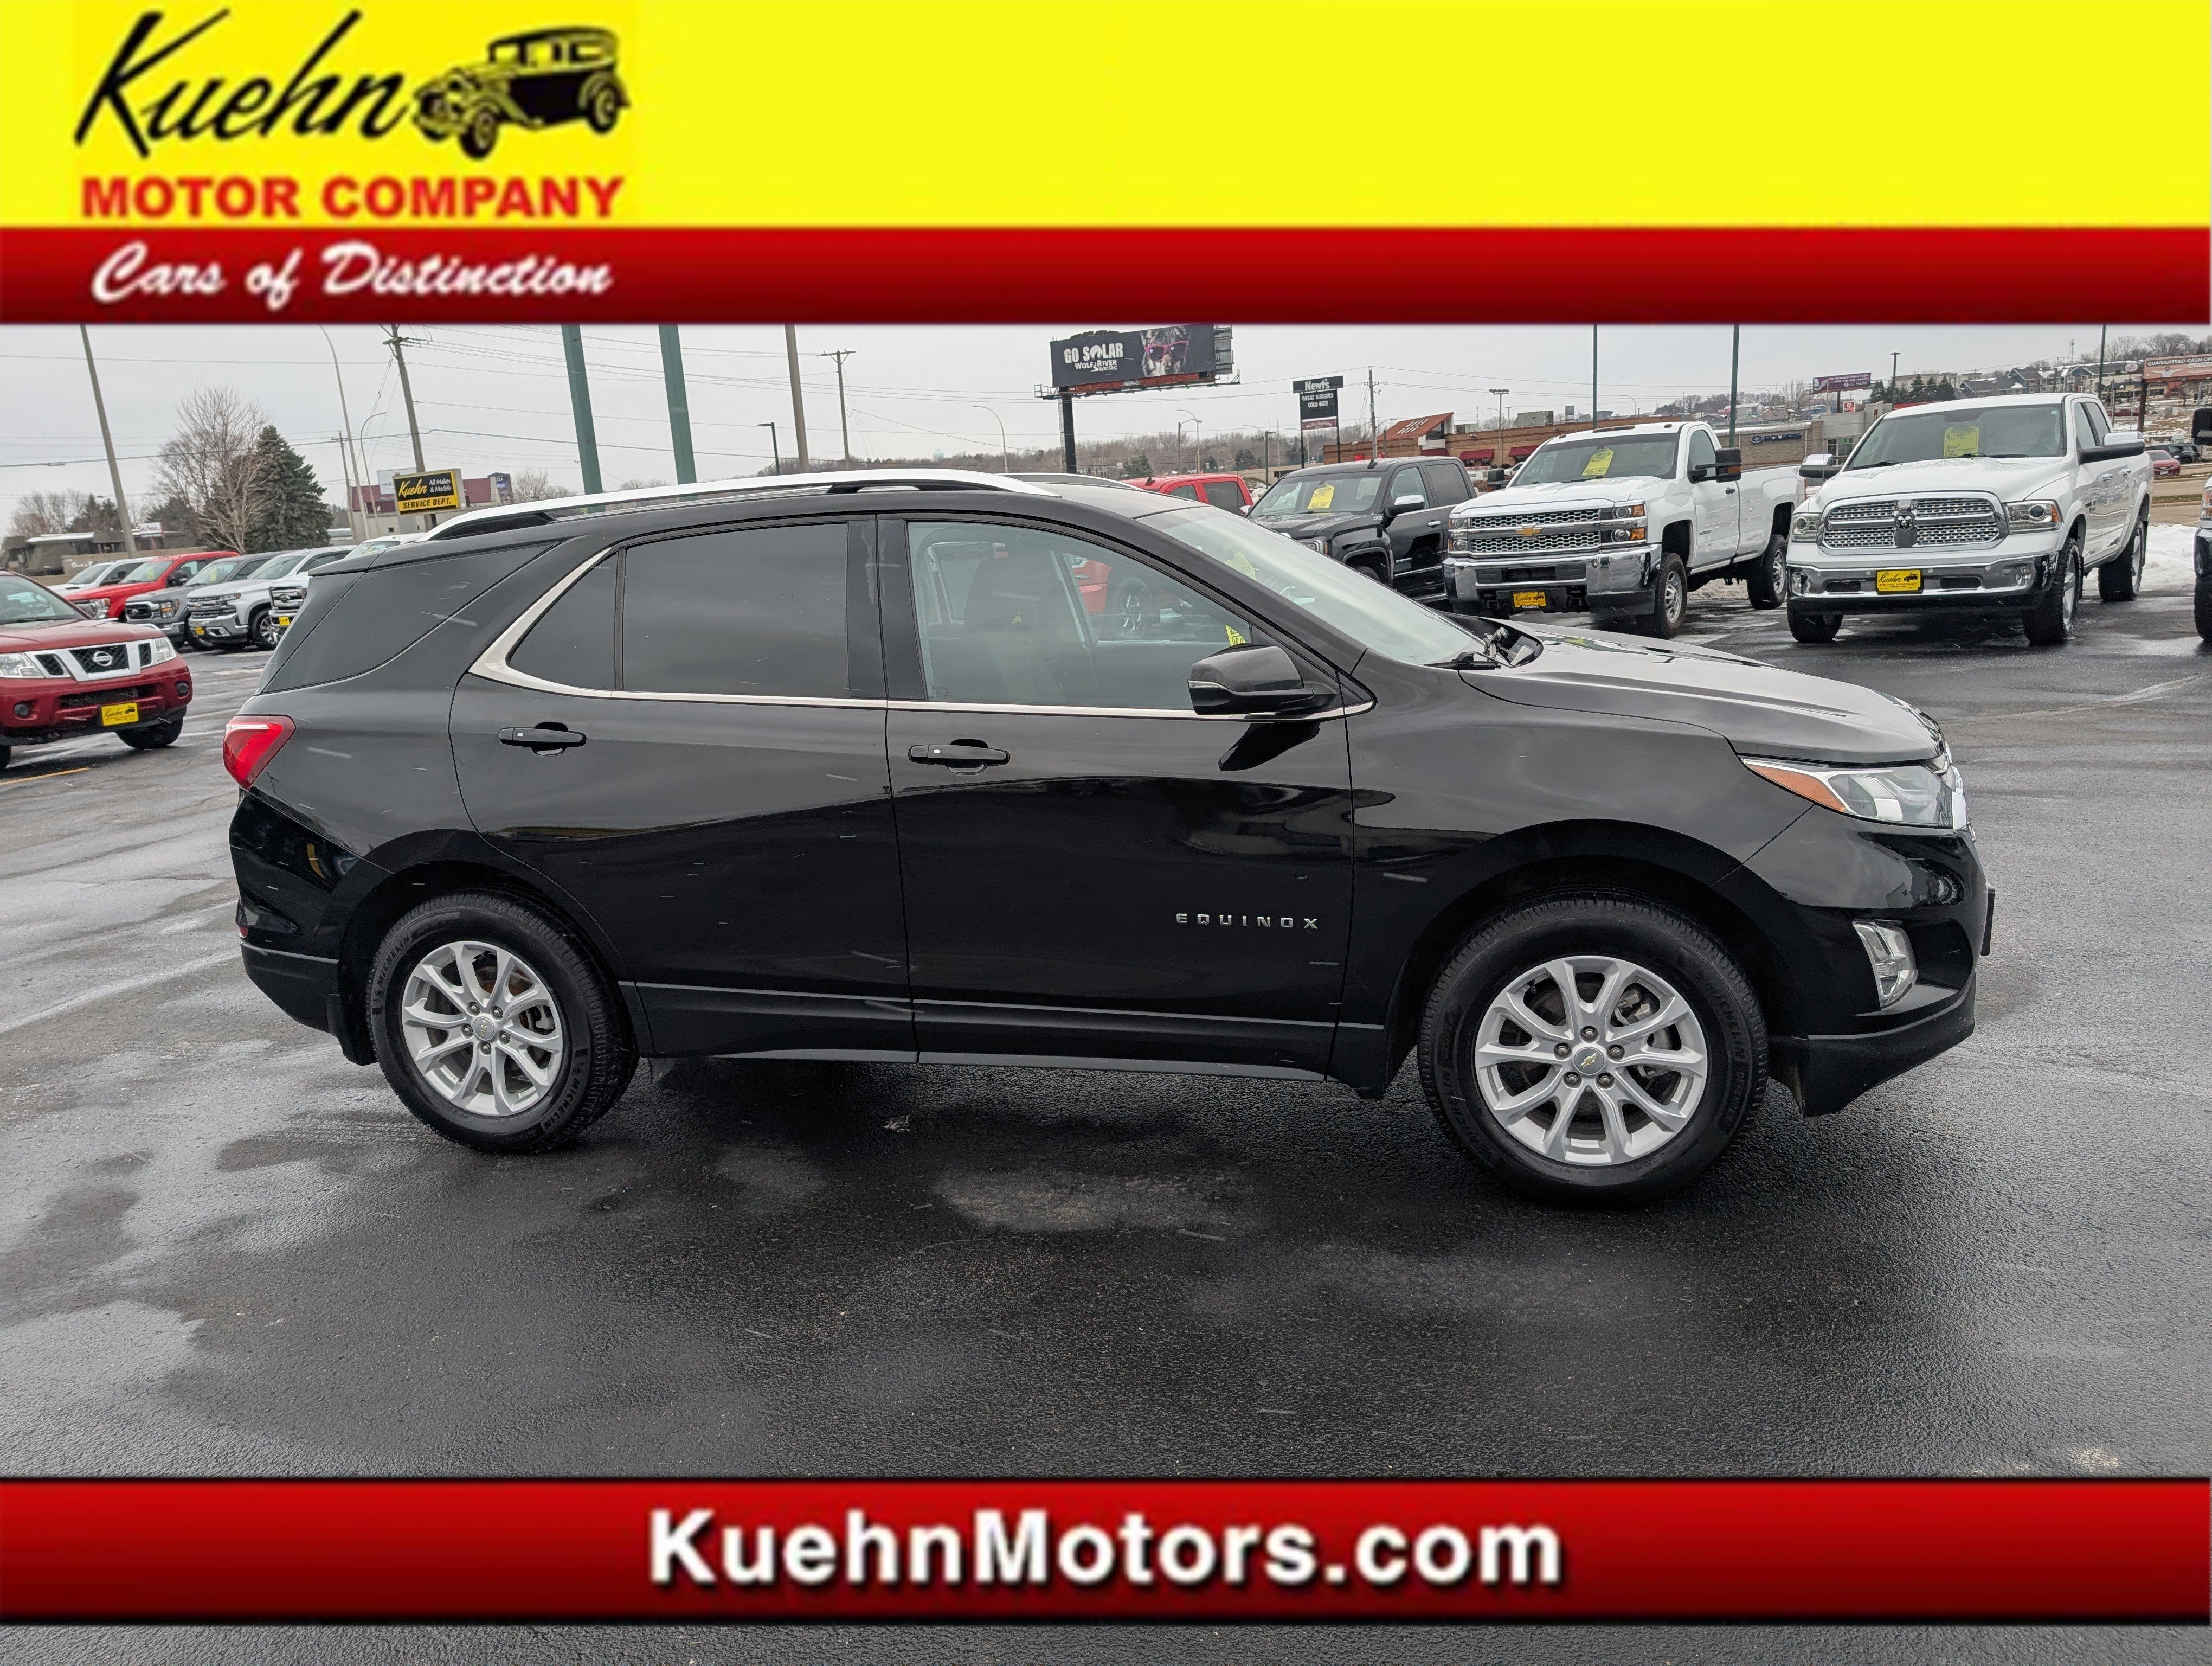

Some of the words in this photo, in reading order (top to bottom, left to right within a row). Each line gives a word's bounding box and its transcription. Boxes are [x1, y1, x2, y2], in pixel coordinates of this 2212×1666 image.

[1064, 348, 1079, 363] GO
[1083, 343, 1124, 361] SOLAR
[1075, 362, 1094, 370] WOLF
[1304, 378, 1330, 390] Newt's
[398, 478, 428, 498] Kuehn
[403, 500, 431, 509] SERVICE
[433, 498, 452, 506] DEPT.
[1879, 572, 1901, 584] Kuehn
[1176, 913, 1317, 930] EQUINOX
[376, 934, 410, 986] MICHELIN
[1712, 990, 1747, 1059] MICHELIN
[543, 1077, 580, 1129] MICHELIN
